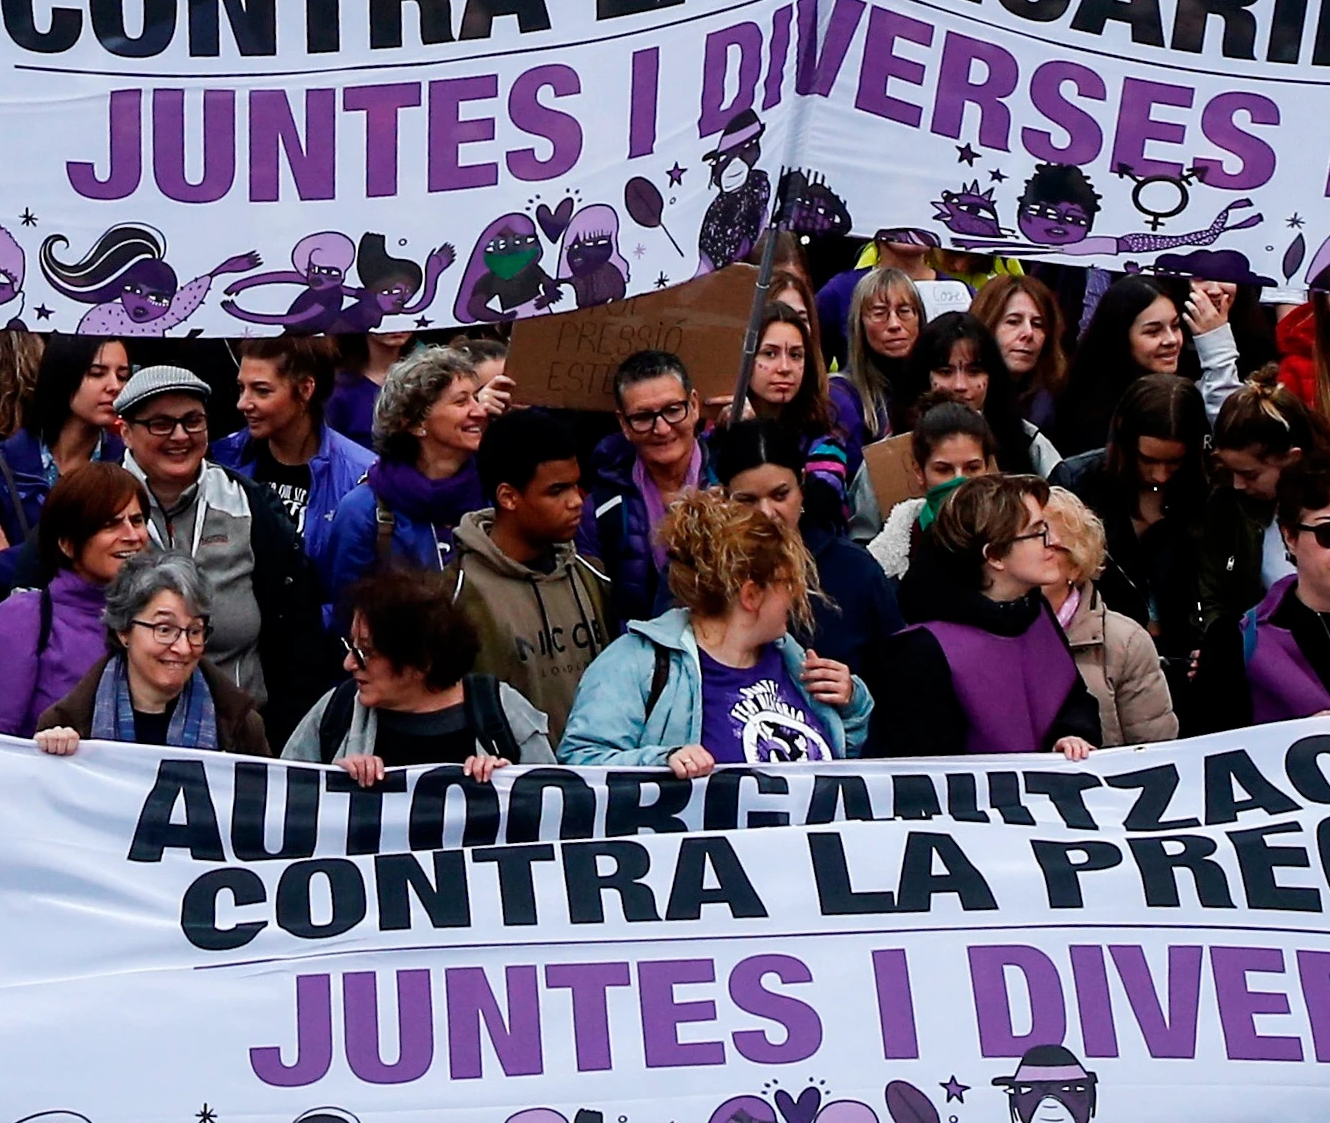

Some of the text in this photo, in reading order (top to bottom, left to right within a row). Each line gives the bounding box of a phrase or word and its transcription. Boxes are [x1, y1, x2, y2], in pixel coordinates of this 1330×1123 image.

[66, 64, 583, 202] JUNTES
[628, 47, 660, 159] I
[547, 355, 619, 395] ESTÈ
[556, 316, 685, 356] PRESSIÓ
[180, 837, 767, 951] CONTRA
[809, 830, 999, 916] LA
[249, 953, 823, 1087] JUNTES
[871, 949, 918, 1060] I
